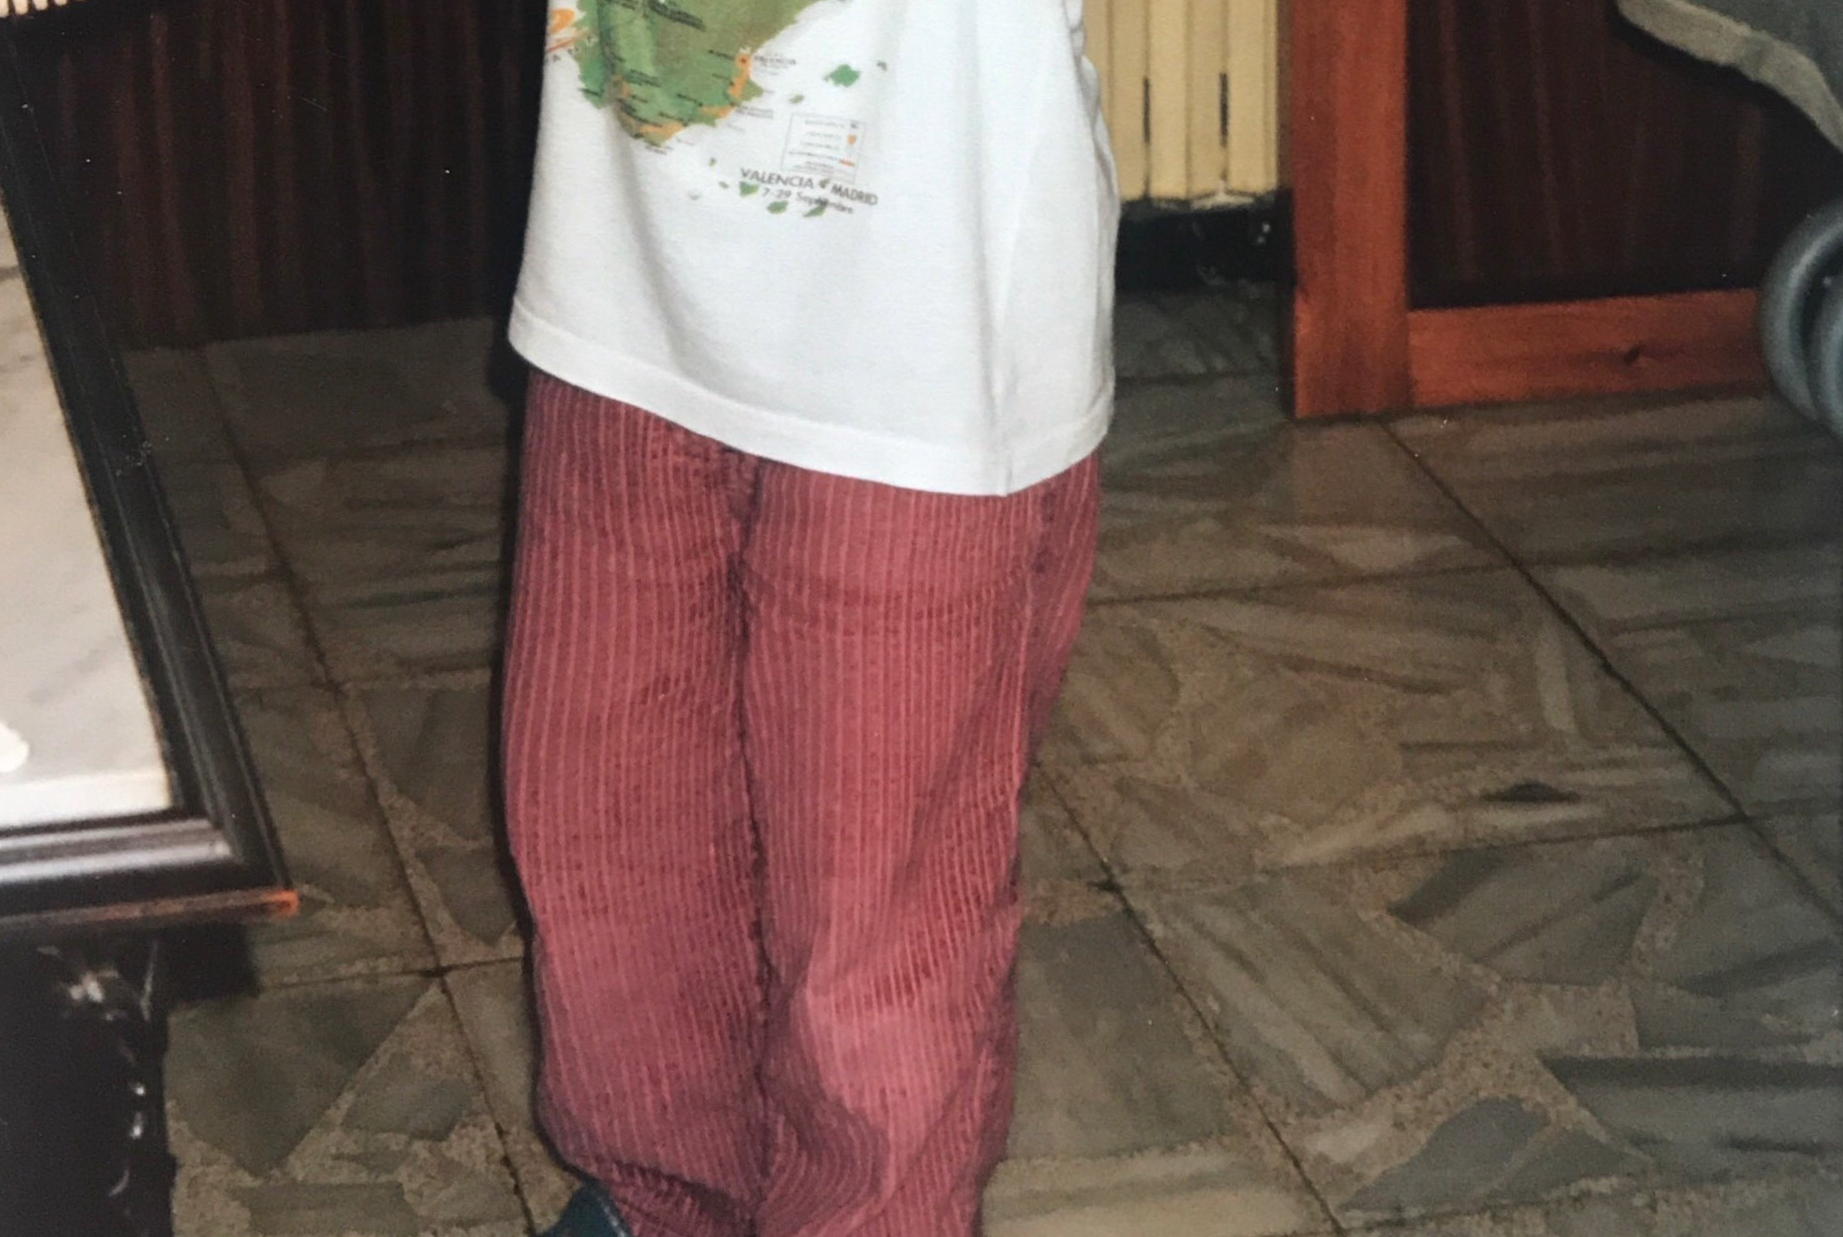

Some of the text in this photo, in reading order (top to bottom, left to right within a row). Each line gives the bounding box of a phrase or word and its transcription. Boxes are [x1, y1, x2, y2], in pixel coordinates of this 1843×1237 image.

[740, 167, 815, 191] VALENCIA
[830, 182, 879, 206] MADRID
[796, 191, 855, 214] Sepmbre
